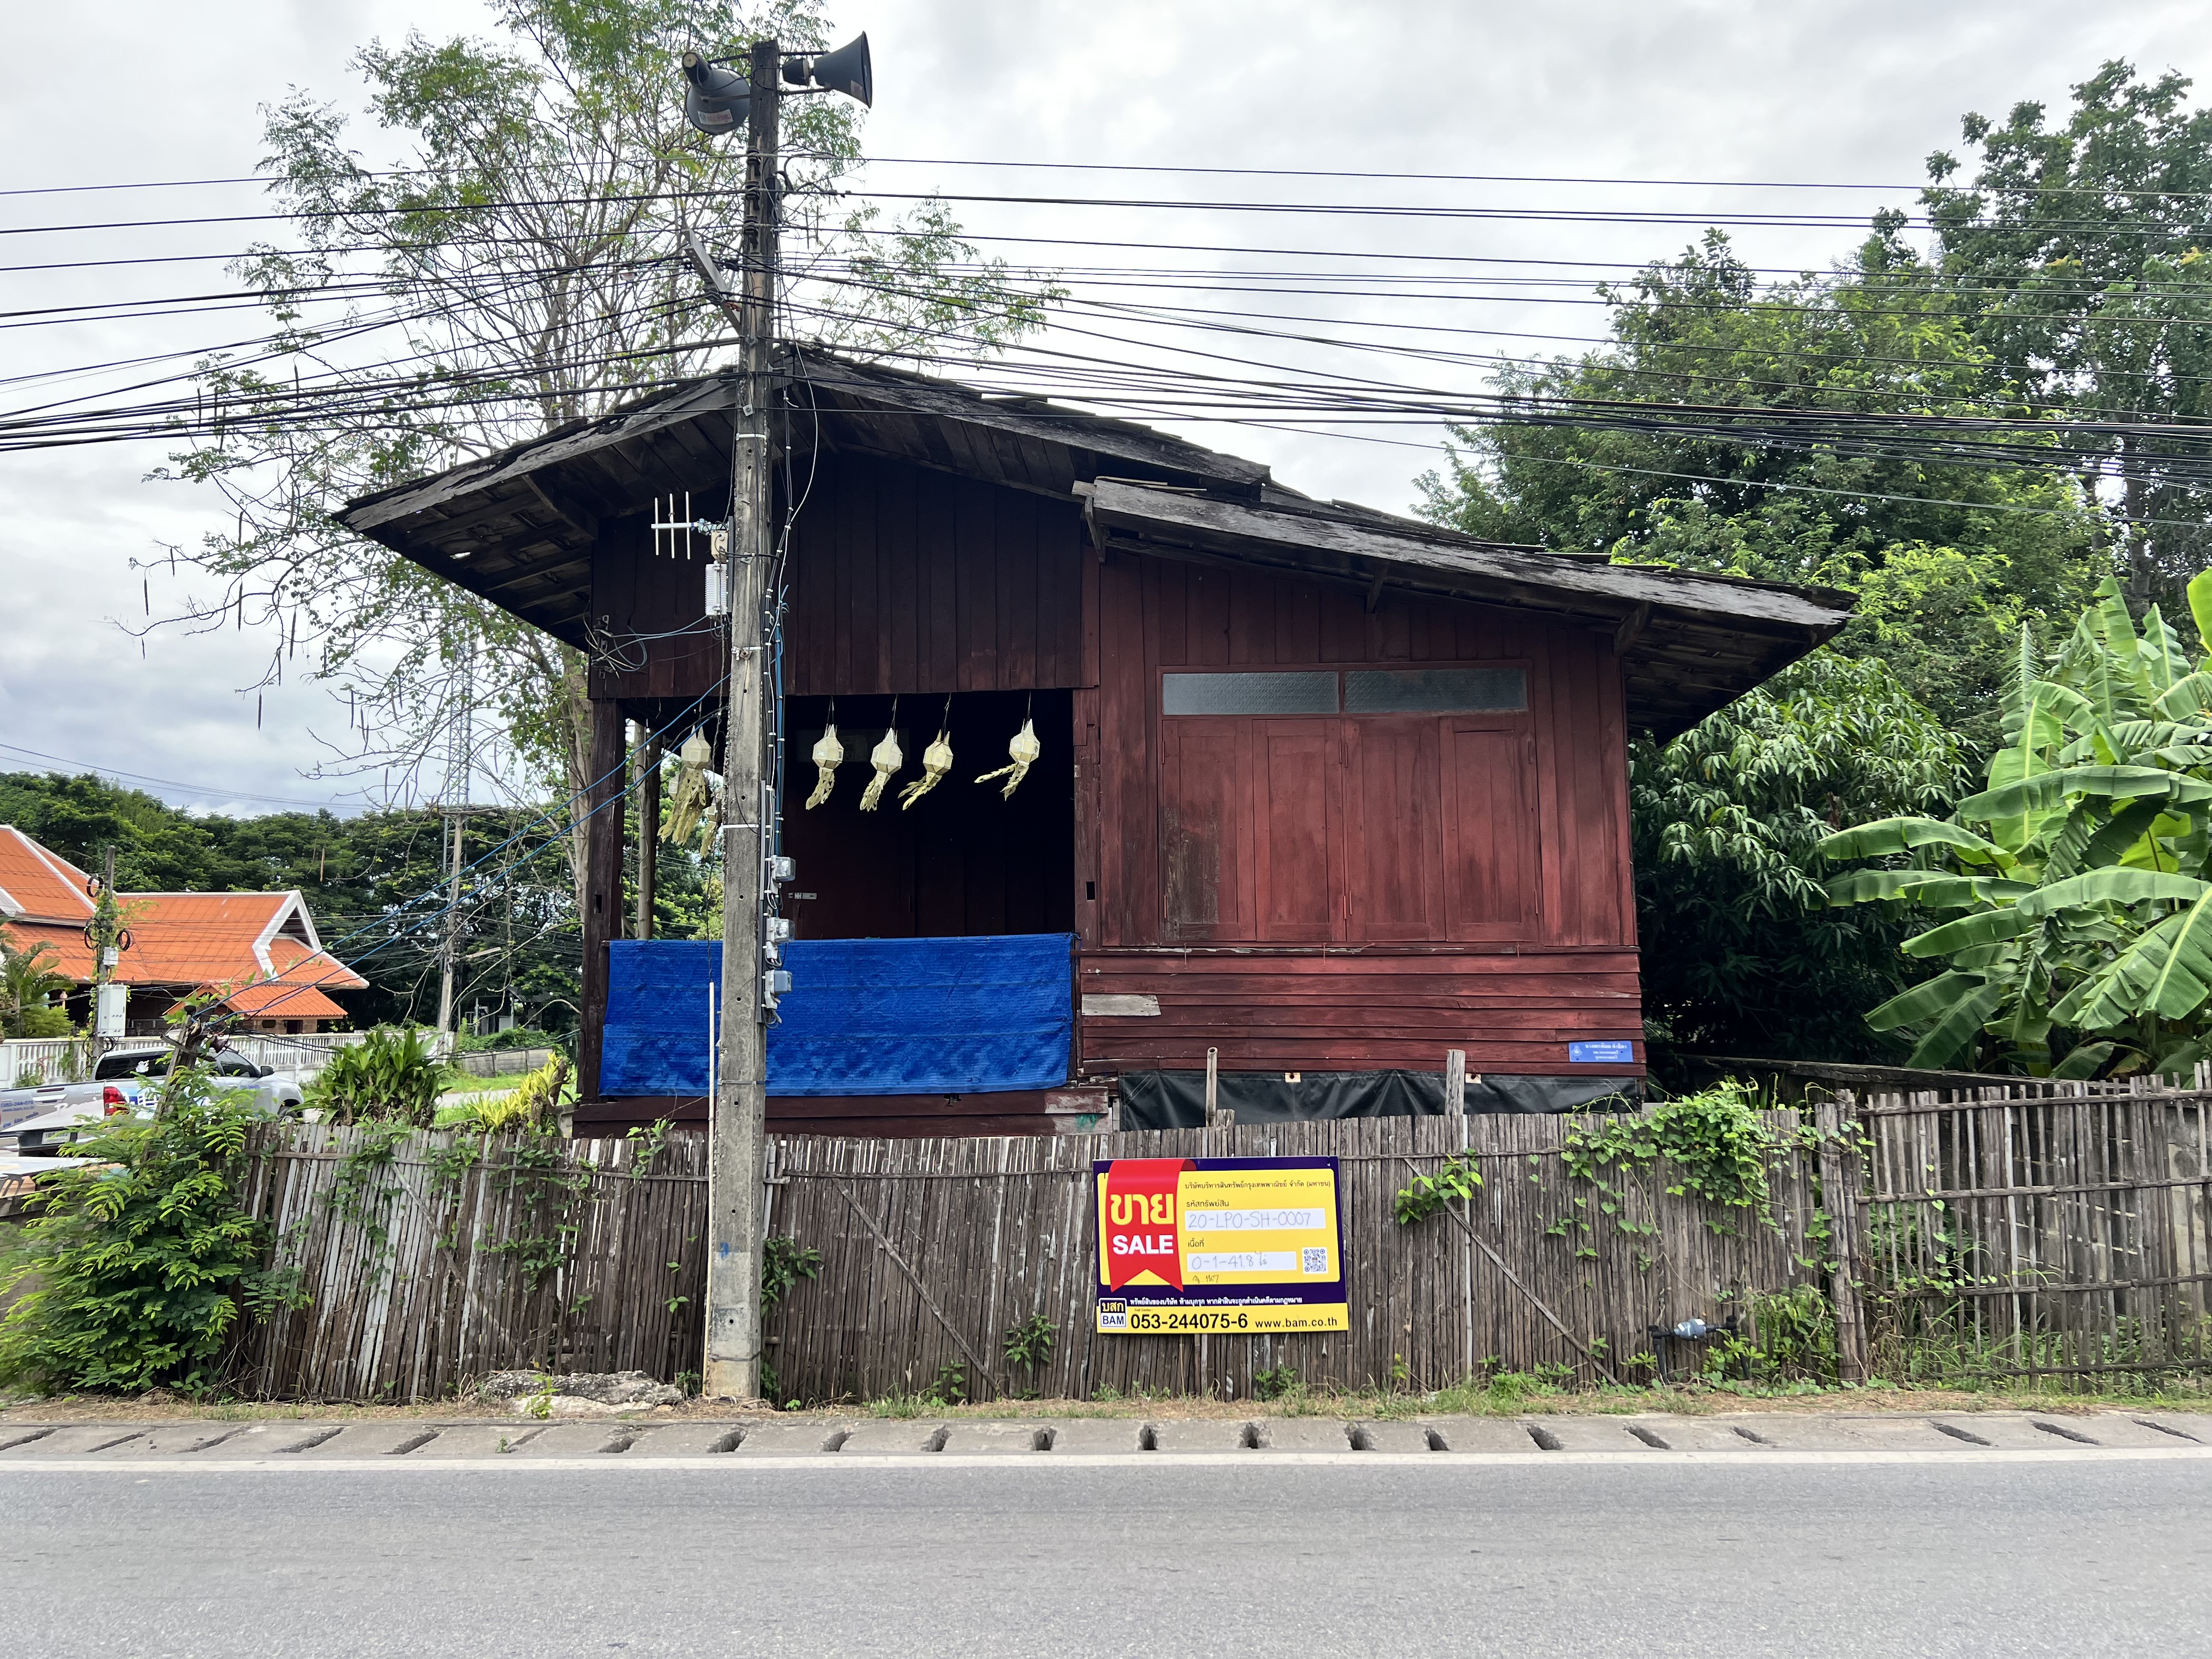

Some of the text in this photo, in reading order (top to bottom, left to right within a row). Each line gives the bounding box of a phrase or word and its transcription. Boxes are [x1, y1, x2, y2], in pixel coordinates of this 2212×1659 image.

[1186, 1199, 1229, 1207] รหัสทรัพย์สิน
[1110, 1193, 1174, 1225] ขาย
[1113, 1234, 1173, 1255] SALE
[1188, 1238, 1204, 1248] เนื้อที่
[1102, 1302, 1124, 1312] บสก
[1103, 1316, 1124, 1325] BAM
[1131, 1313, 1337, 1329] 053-244075-6 www.bam.co.th
